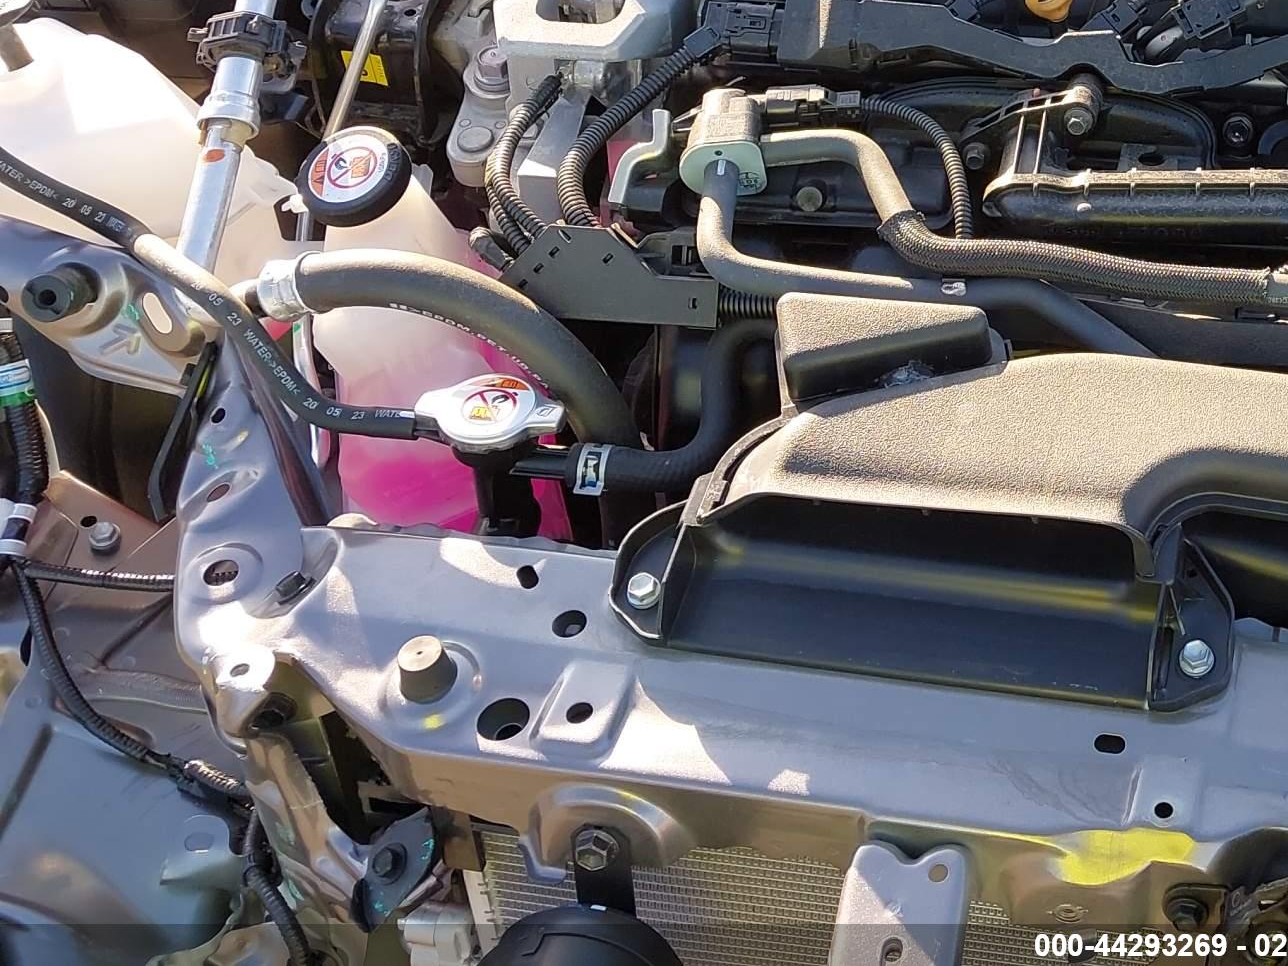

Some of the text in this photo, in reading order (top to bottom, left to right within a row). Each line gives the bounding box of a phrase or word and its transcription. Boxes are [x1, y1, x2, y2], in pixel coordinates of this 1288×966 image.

[208, 293, 224, 306] 05
[226, 312, 243, 326] 23
[243, 327, 272, 362] WATER
[303, 397, 319, 410] 20
[351, 411, 365, 420] 23
